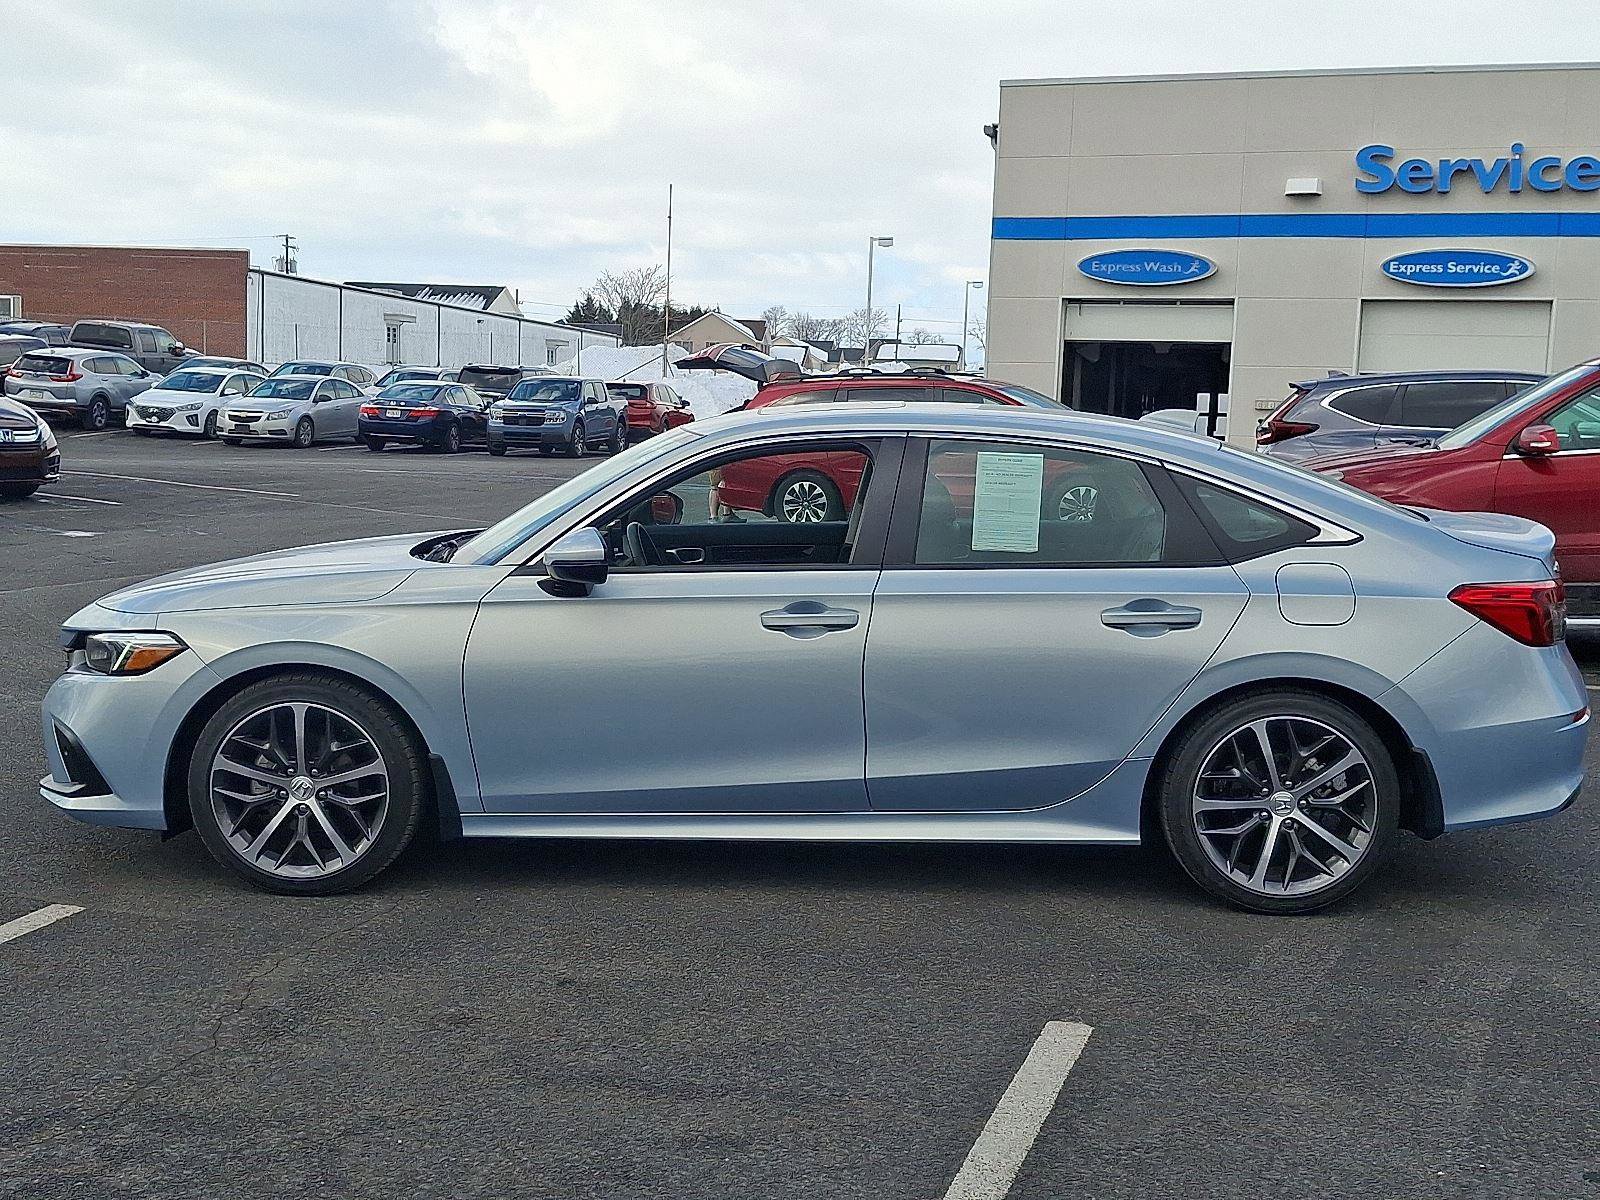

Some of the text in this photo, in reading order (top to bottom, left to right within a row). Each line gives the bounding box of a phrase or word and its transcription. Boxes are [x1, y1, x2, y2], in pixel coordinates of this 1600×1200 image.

[1355, 142, 1600, 194] Service
[1091, 261, 1182, 274] Express Wash
[1389, 261, 1501, 275] Express Service
